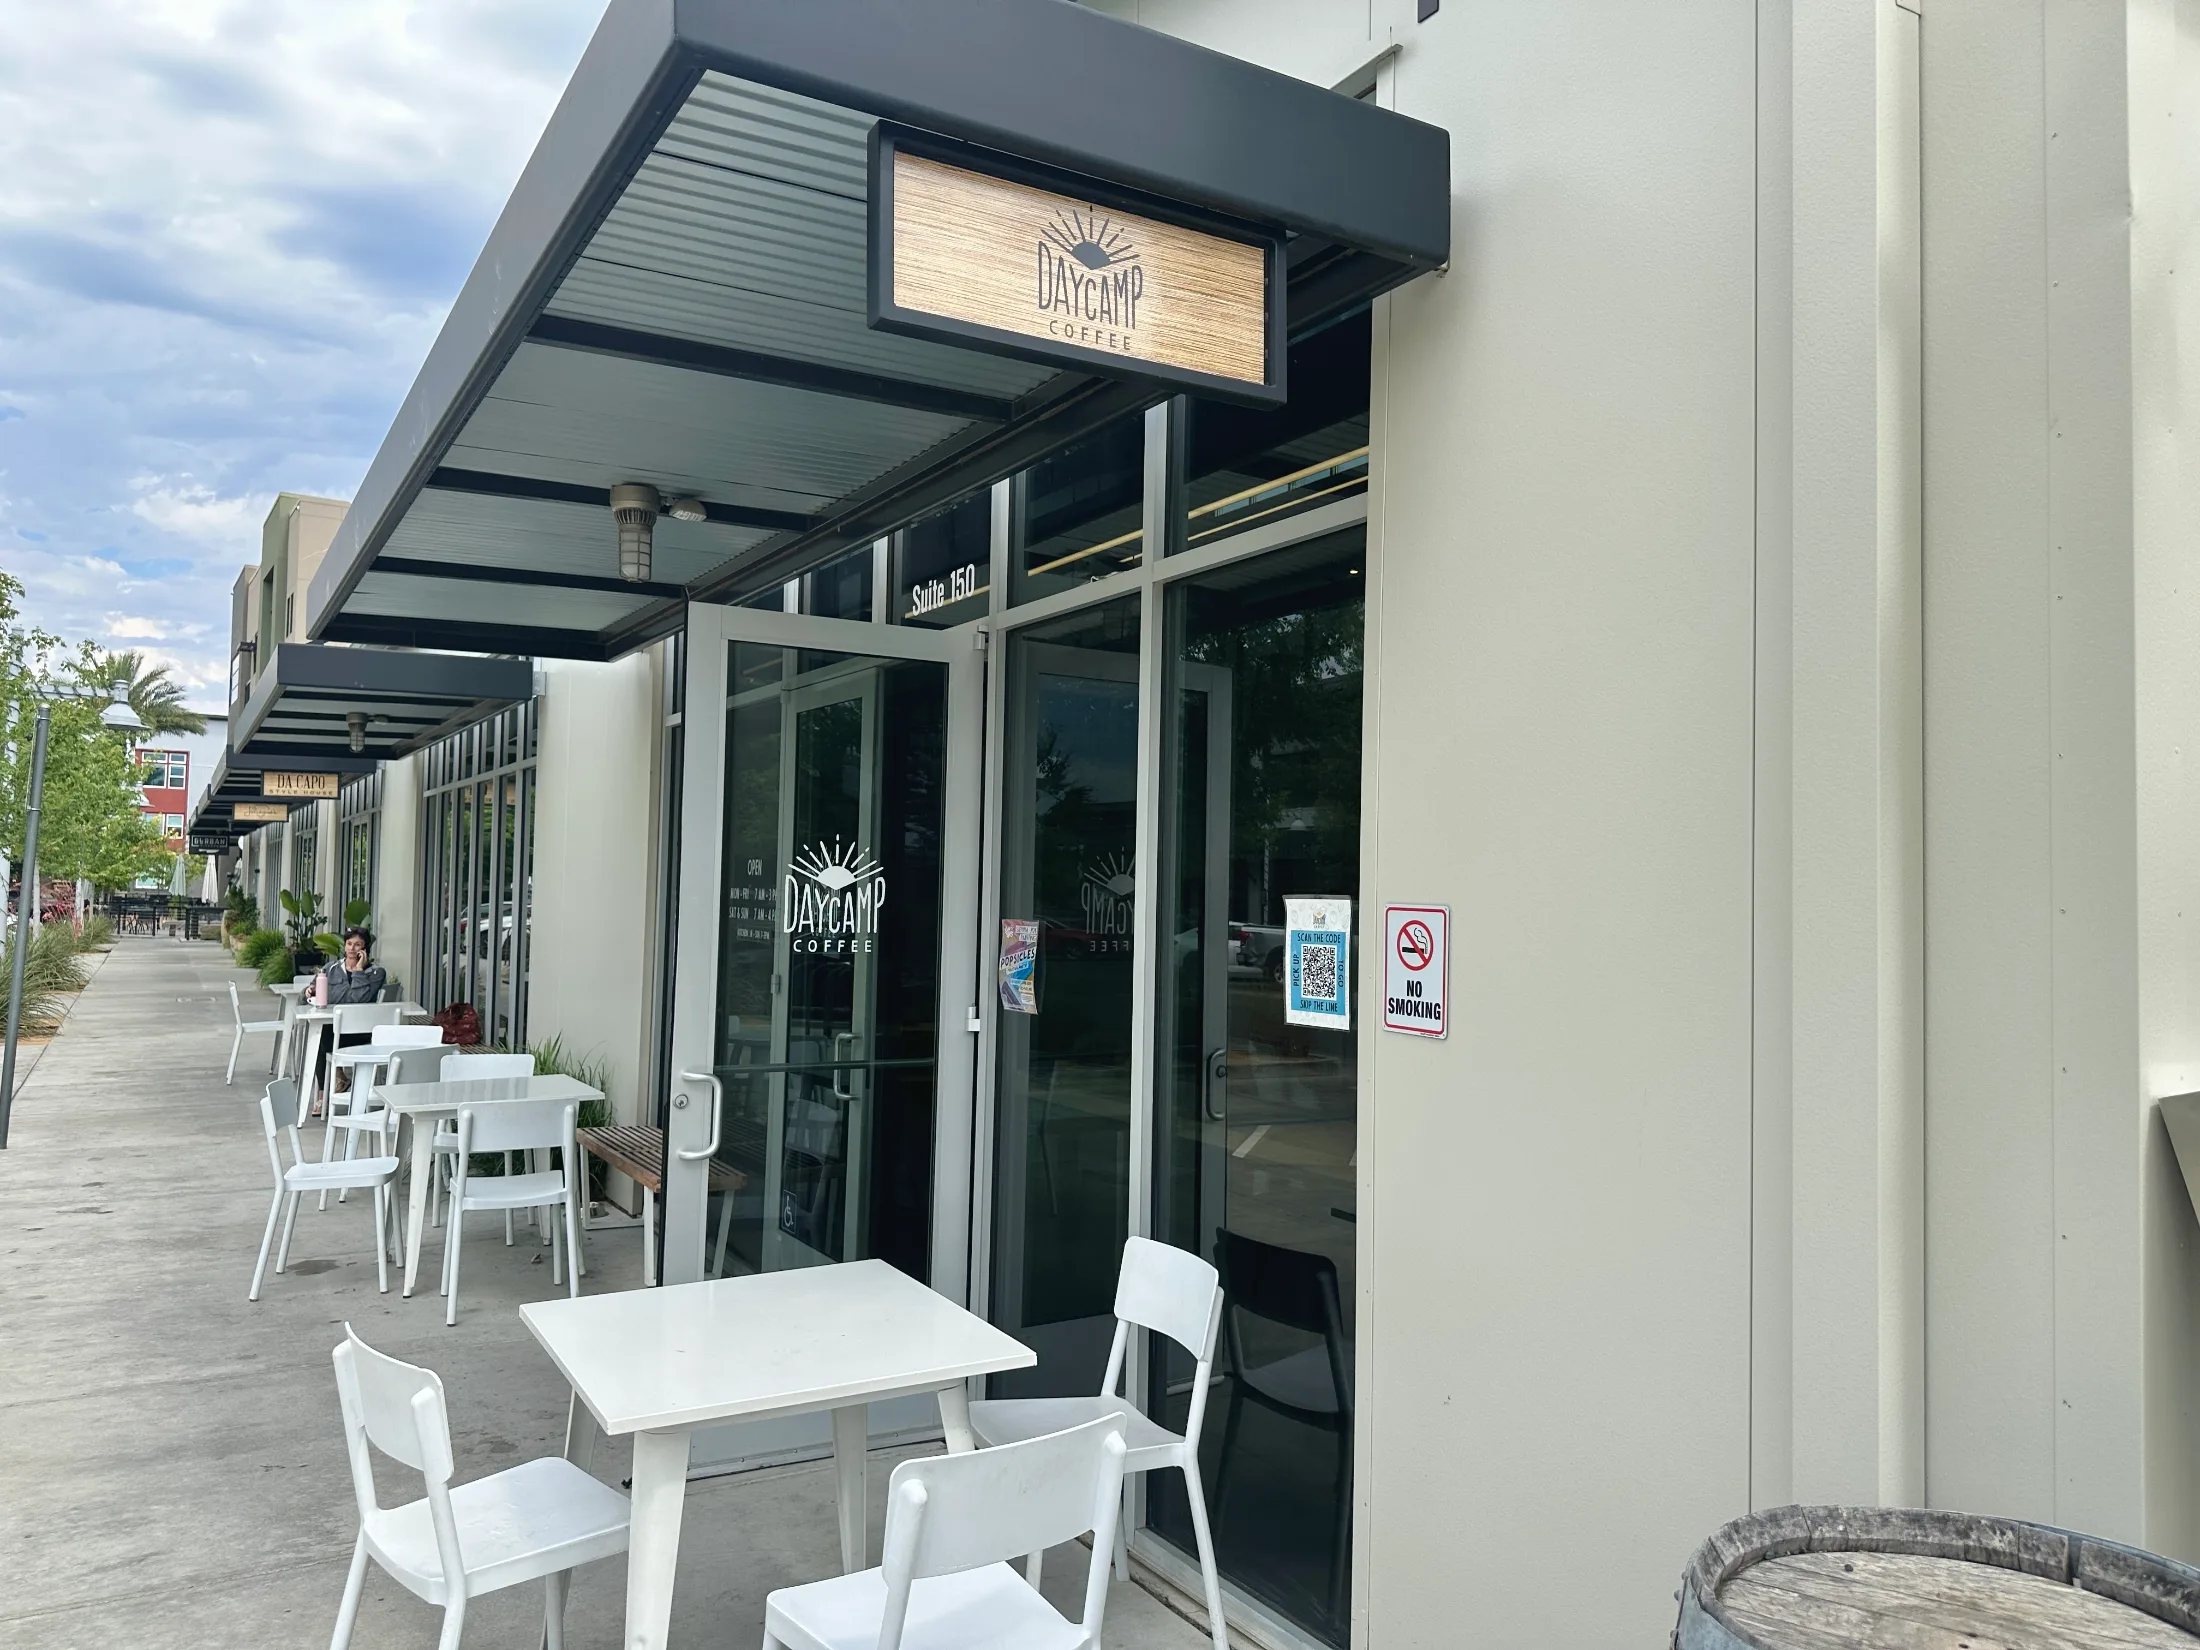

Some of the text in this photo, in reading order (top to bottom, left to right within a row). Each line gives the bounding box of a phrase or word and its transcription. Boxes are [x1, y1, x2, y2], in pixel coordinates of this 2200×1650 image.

[1038, 240, 1143, 330] DAYCAMP
[1049, 320, 1132, 351] COFFEE
[912, 563, 975, 616] Suite 150
[277, 774, 325, 790] DA CAPO
[747, 859, 763, 876] OPEN
[783, 874, 886, 934] DAYCAMP
[793, 940, 872, 953] COFFEE
[1297, 933, 1341, 943] SCAN THE CODE
[1000, 948, 1035, 969] POPSICLES
[1293, 954, 1300, 965] UP
[1338, 960, 1344, 988] TO GO
[1406, 980, 1423, 998] NO
[1300, 1000, 1338, 1012] SKIP THE LINE
[1388, 997, 1441, 1020] SMOKING
